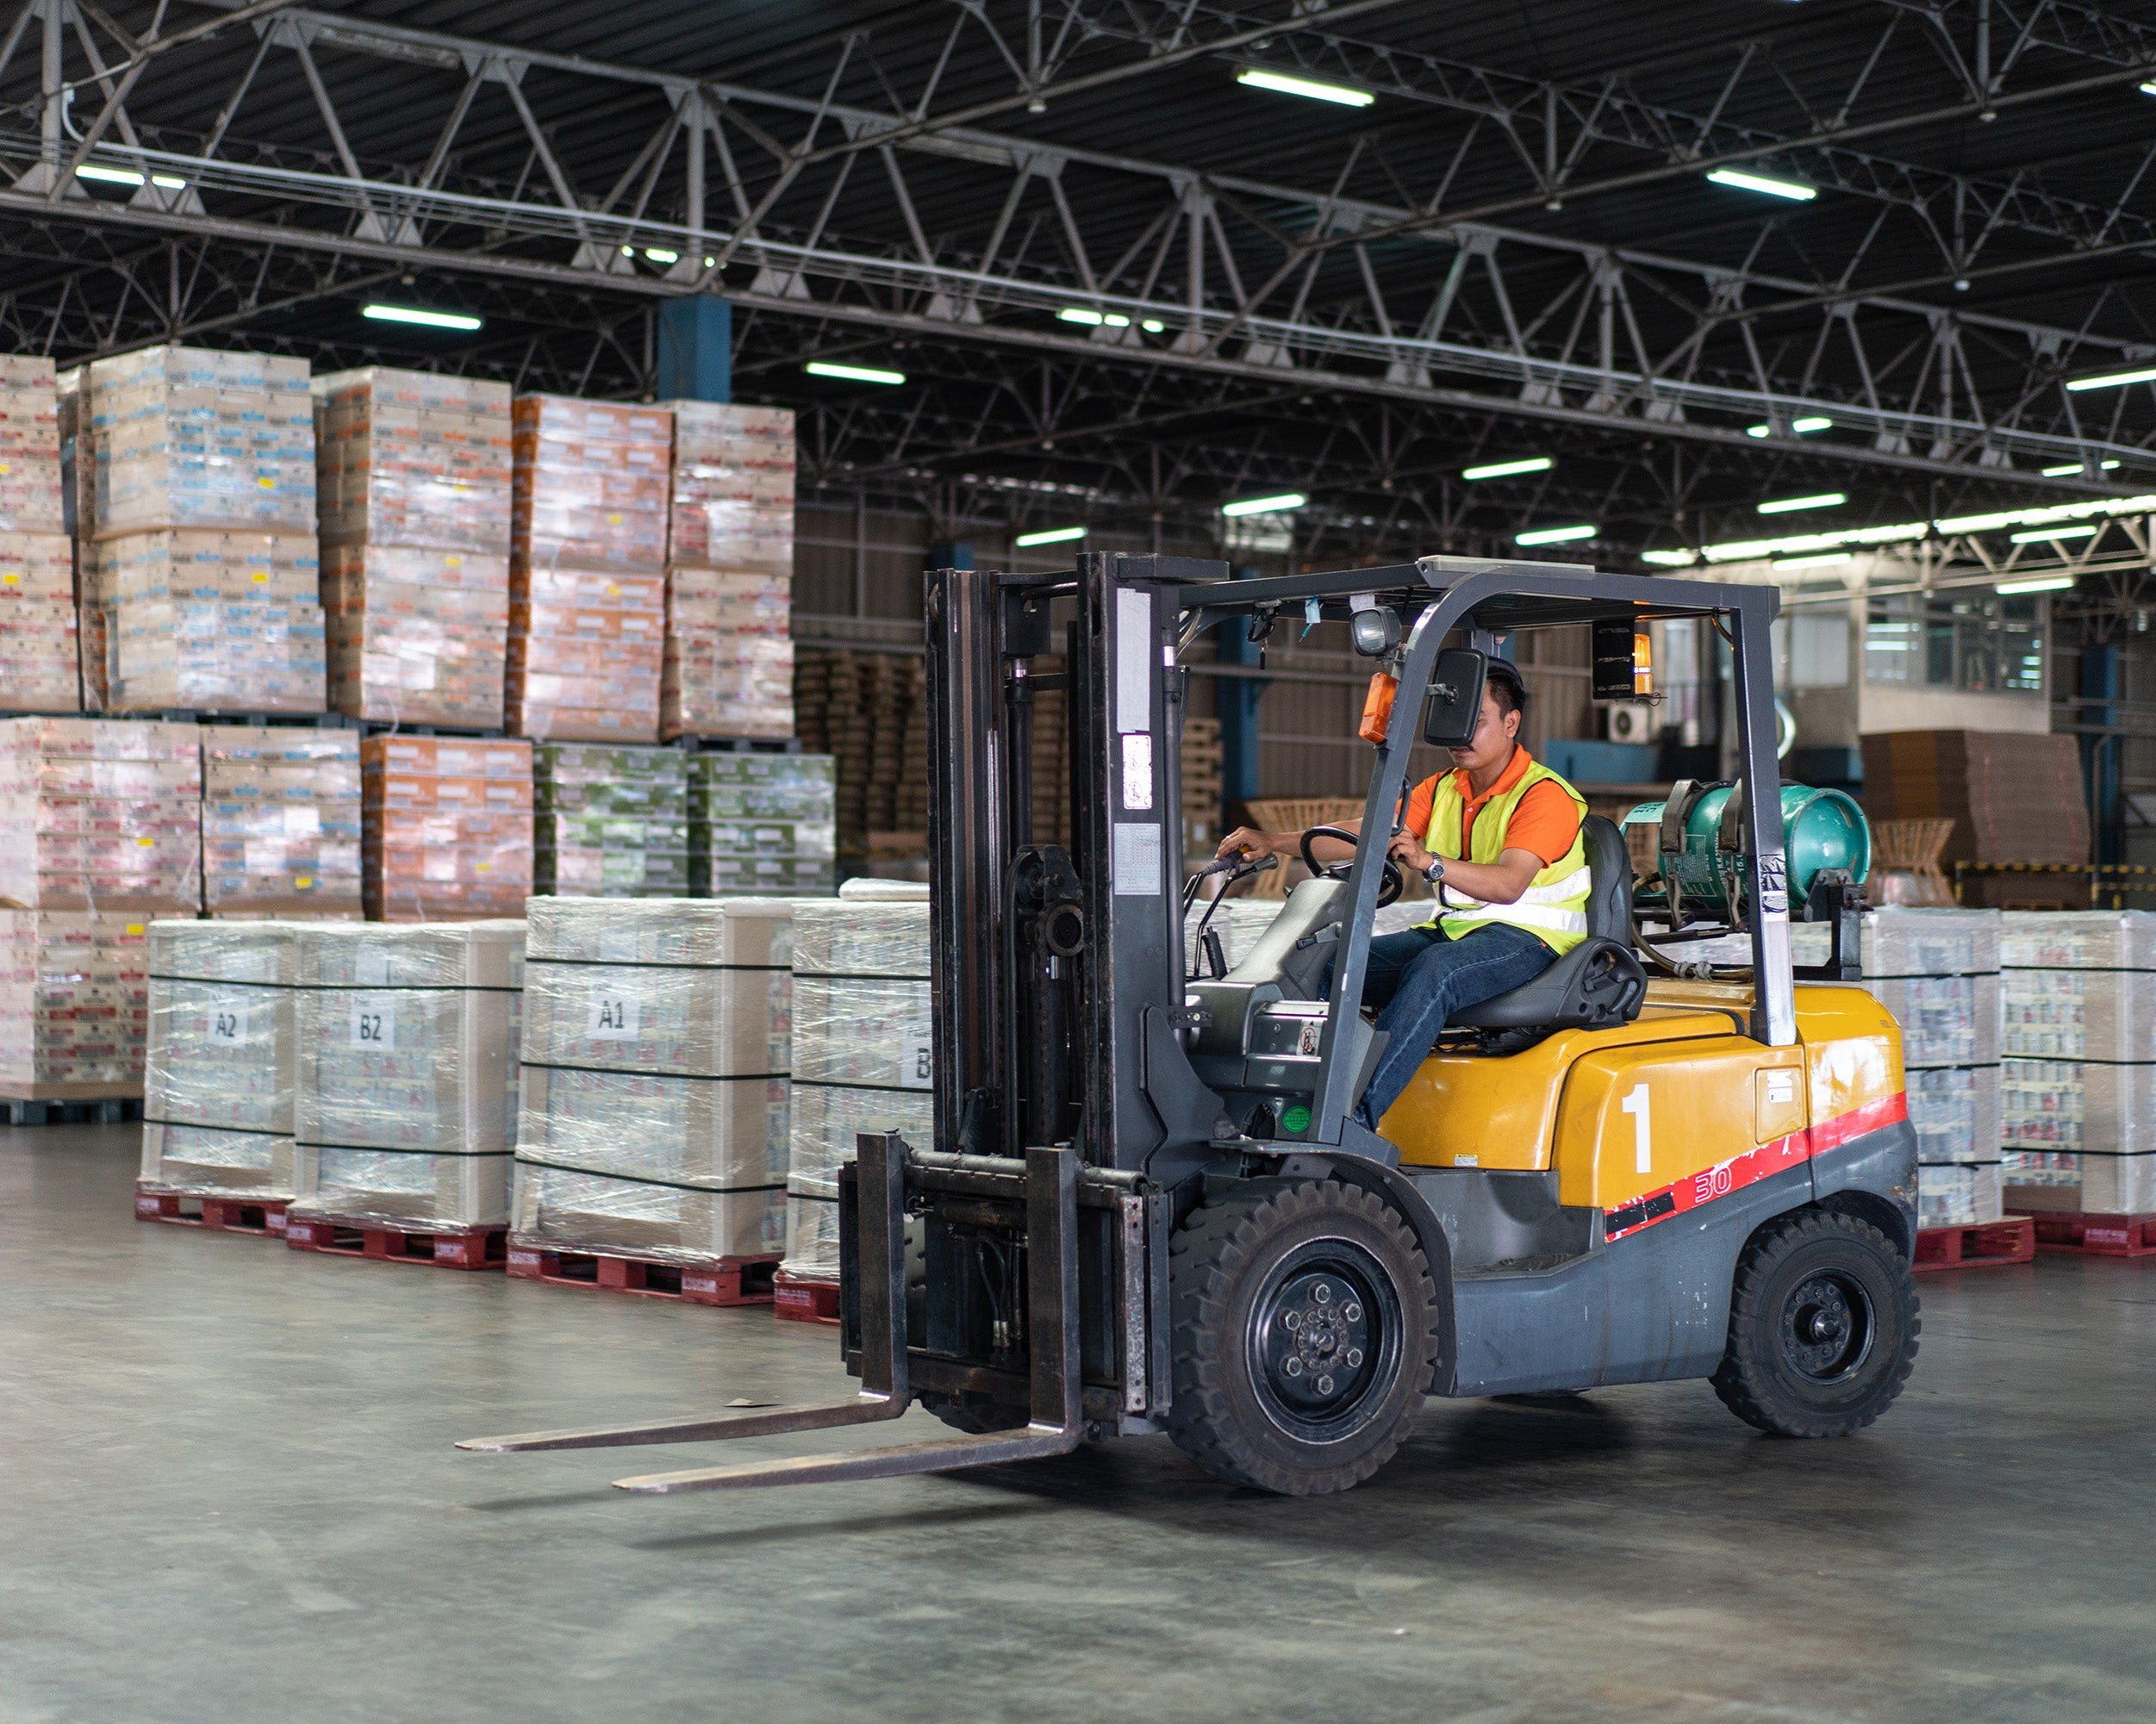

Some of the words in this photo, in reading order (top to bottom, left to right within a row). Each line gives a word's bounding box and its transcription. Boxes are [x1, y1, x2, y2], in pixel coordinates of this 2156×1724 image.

[215, 1011, 236, 1038] A2
[359, 1014, 383, 1041] B2
[598, 1000, 624, 1029] A1
[916, 1048, 932, 1079] B
[1622, 1083, 1651, 1173] 1
[1694, 1166, 1732, 1204] 30
